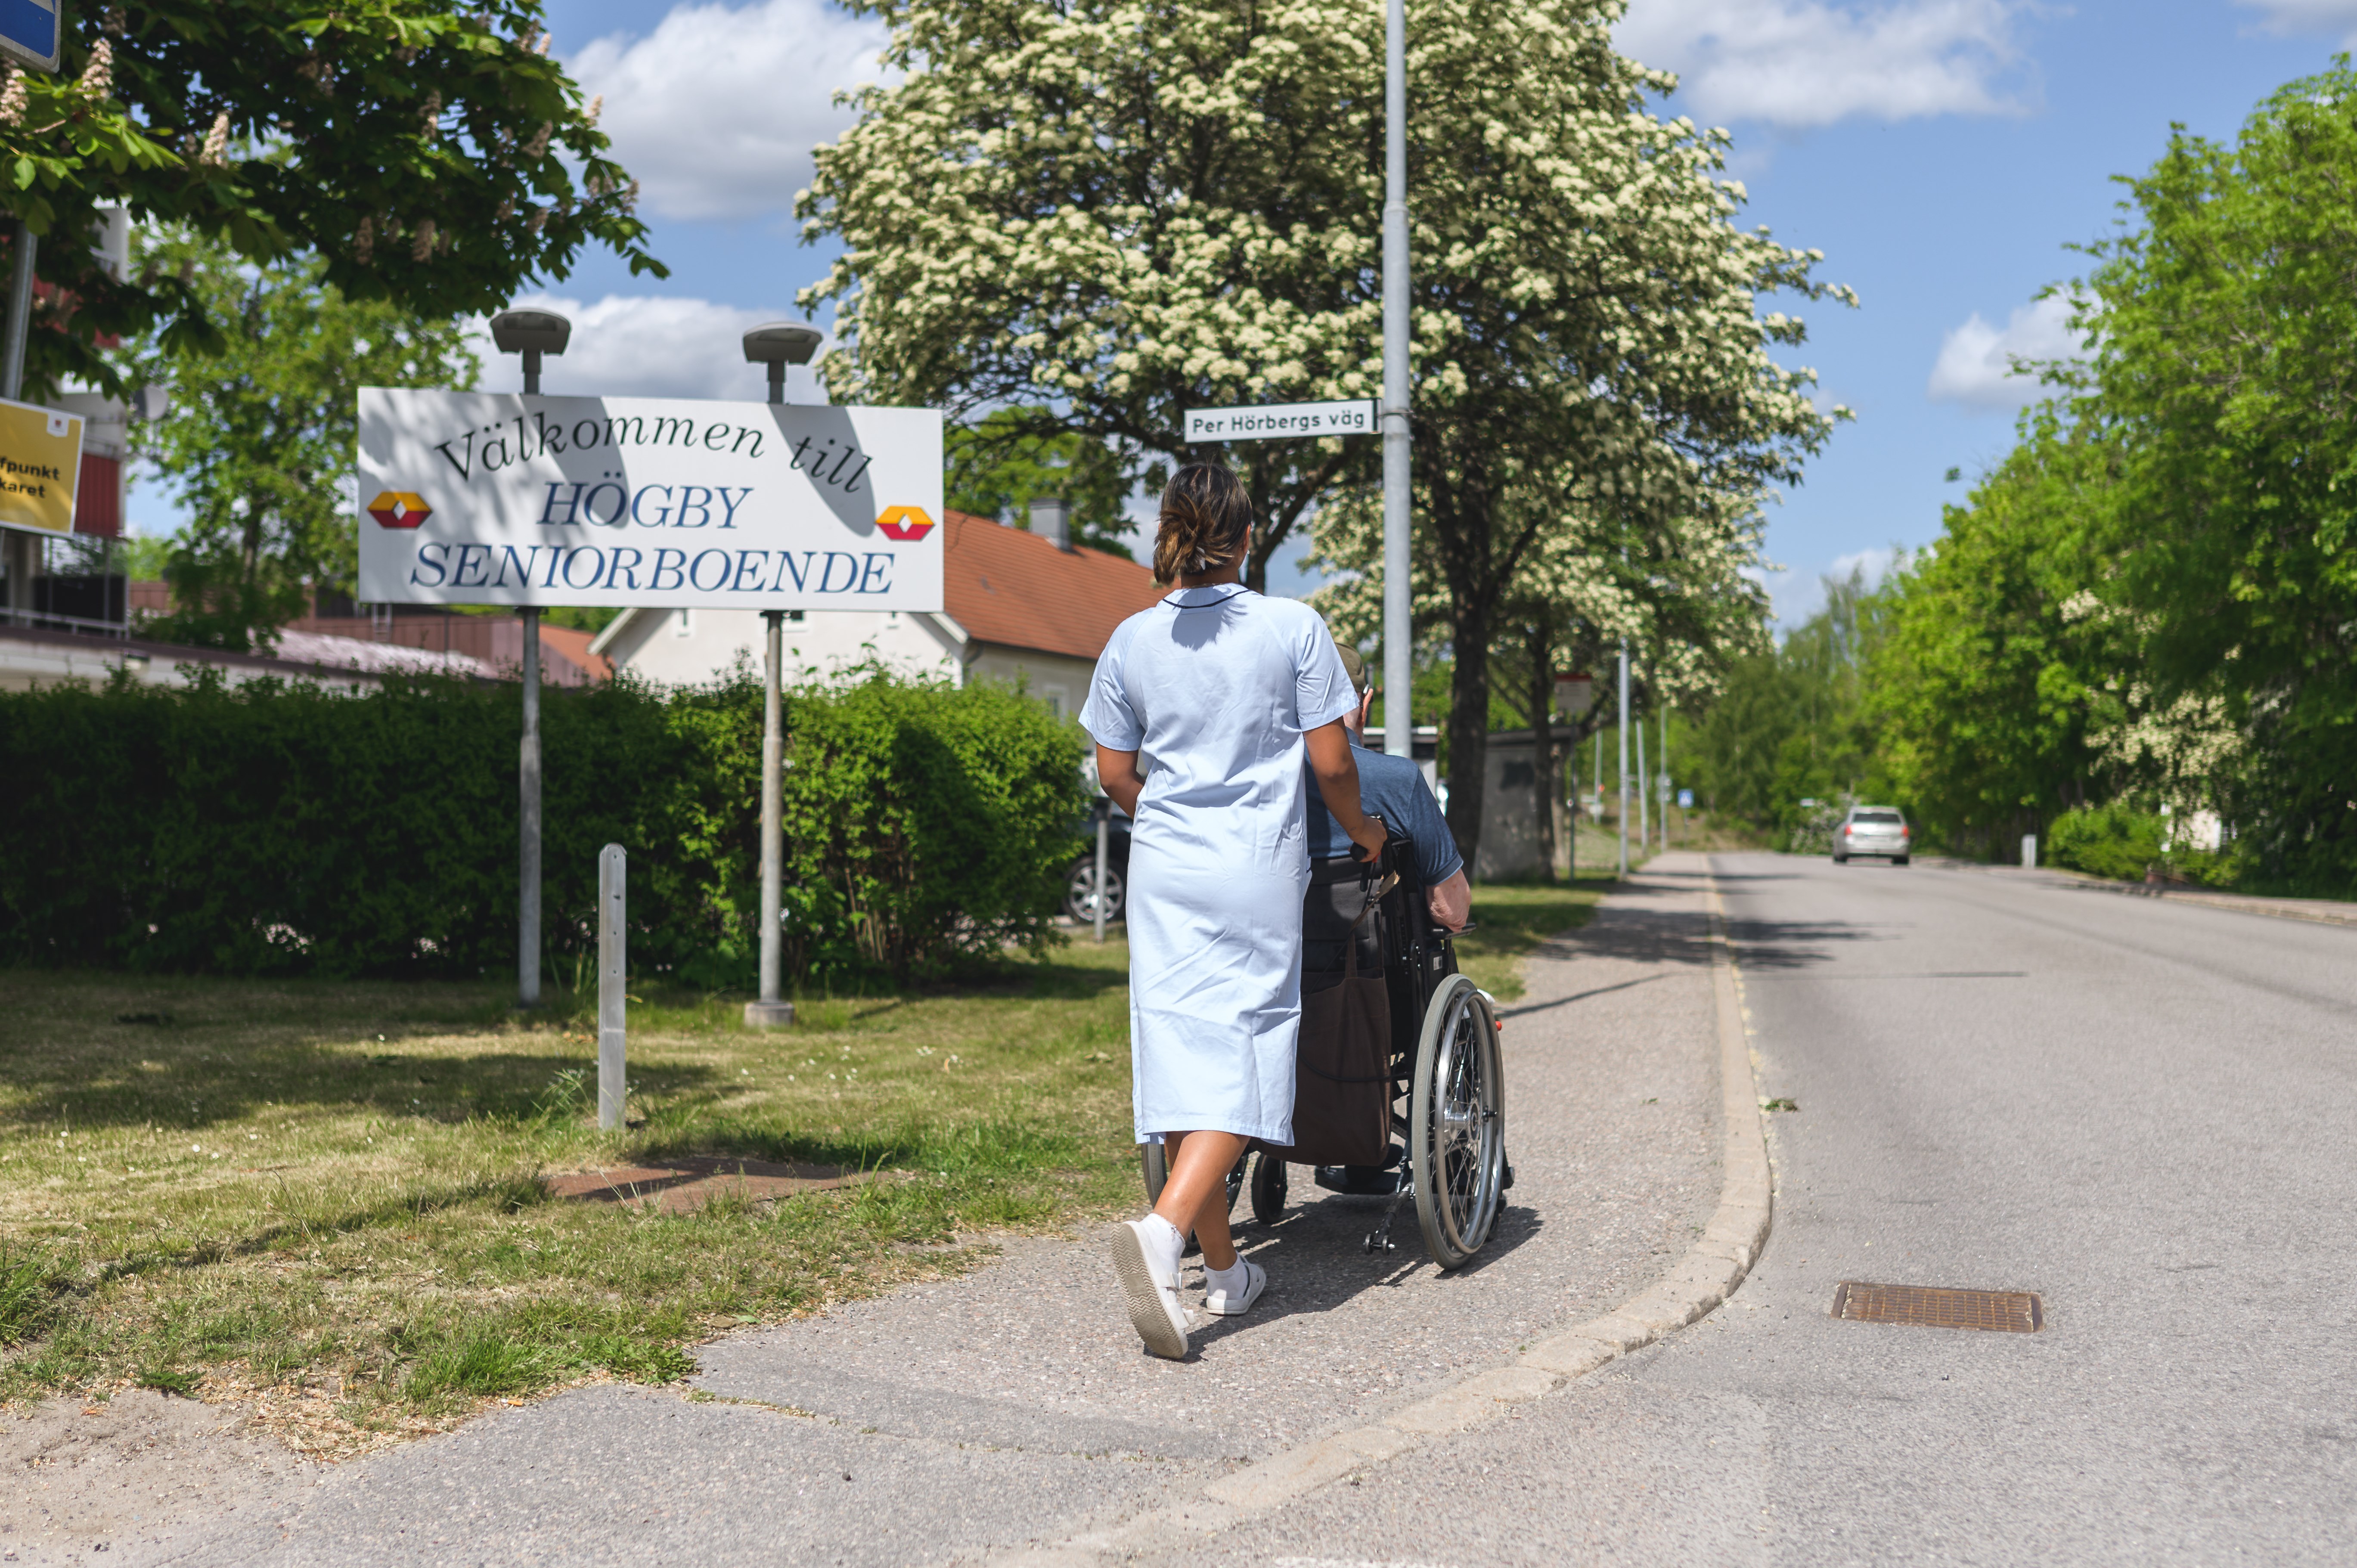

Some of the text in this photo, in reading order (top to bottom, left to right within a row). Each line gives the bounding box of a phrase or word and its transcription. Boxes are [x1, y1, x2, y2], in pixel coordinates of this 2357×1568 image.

[1193, 410, 1365, 433] Per Hörbergs väg
[434, 412, 874, 493] Välkommen till
[535, 470, 755, 530] HÖGBY
[409, 541, 896, 594] SENIORBOENDE
